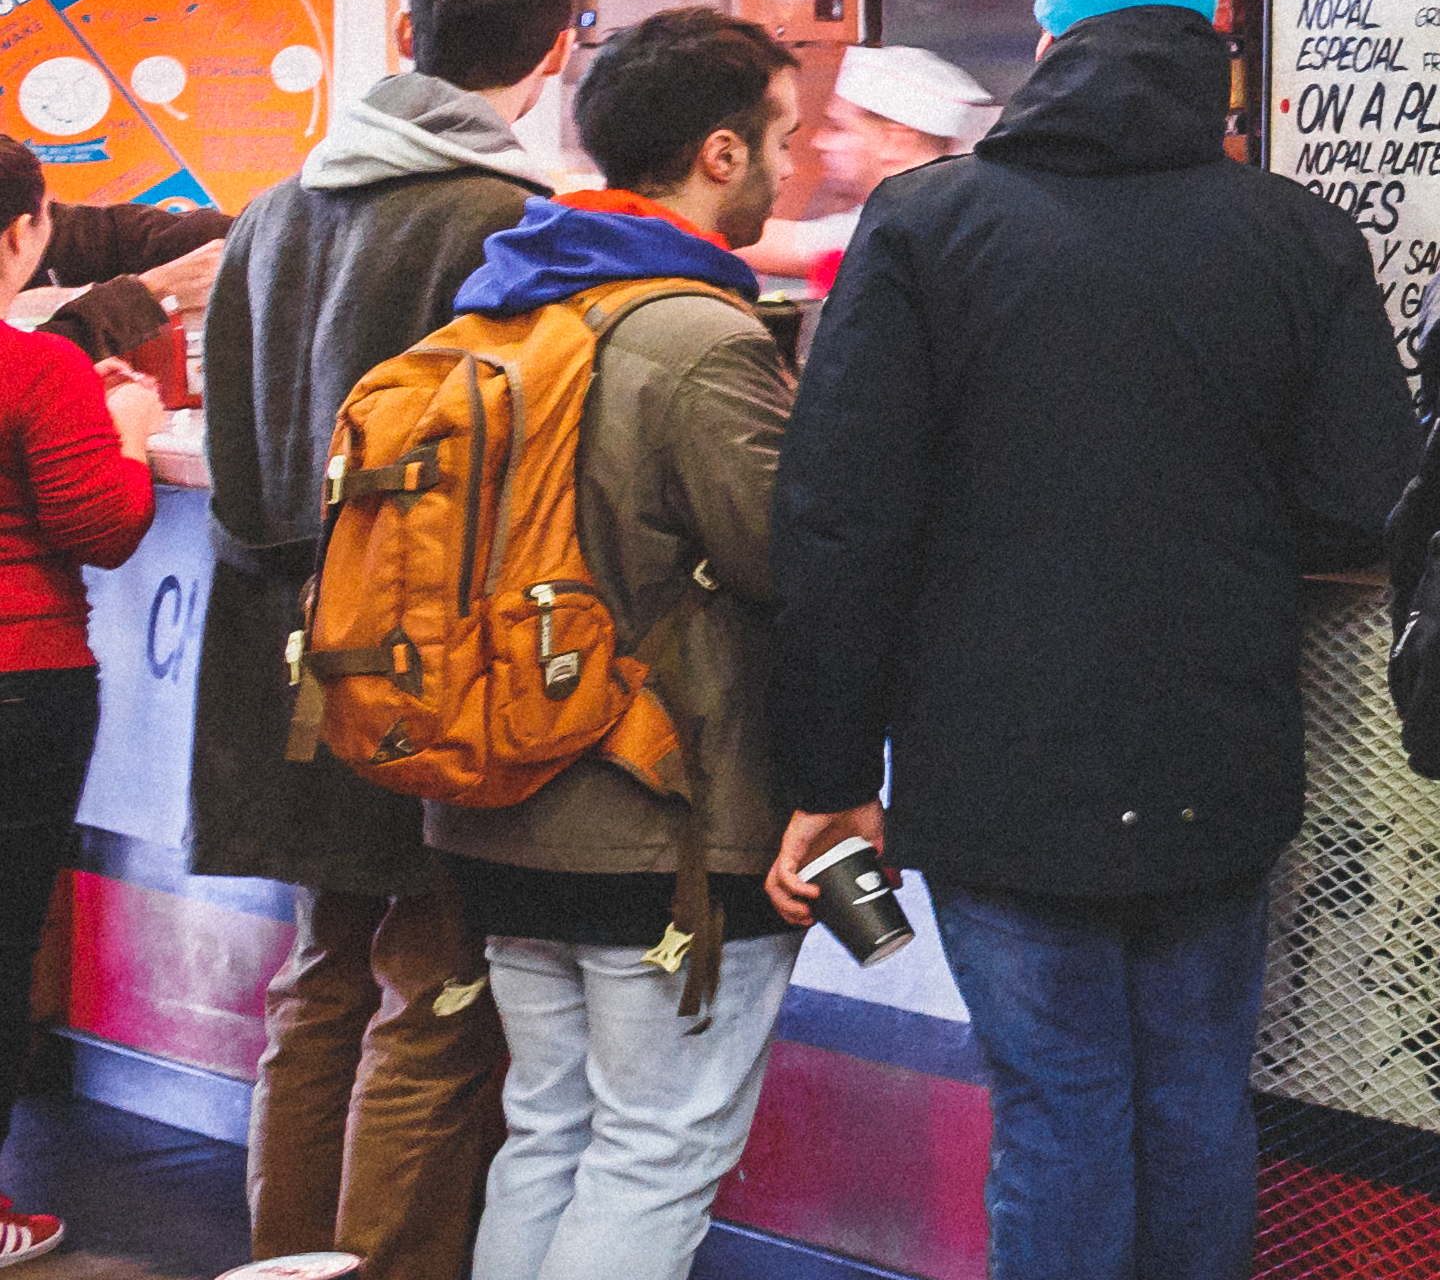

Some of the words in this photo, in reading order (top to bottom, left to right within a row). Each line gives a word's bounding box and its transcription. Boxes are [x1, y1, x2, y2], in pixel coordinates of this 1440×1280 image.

[1295, 35, 1410, 73] ESPECIAL
[1296, 83, 1355, 135] ON
[1359, 81, 1387, 133] A
[1295, 139, 1374, 177] NOPAL
